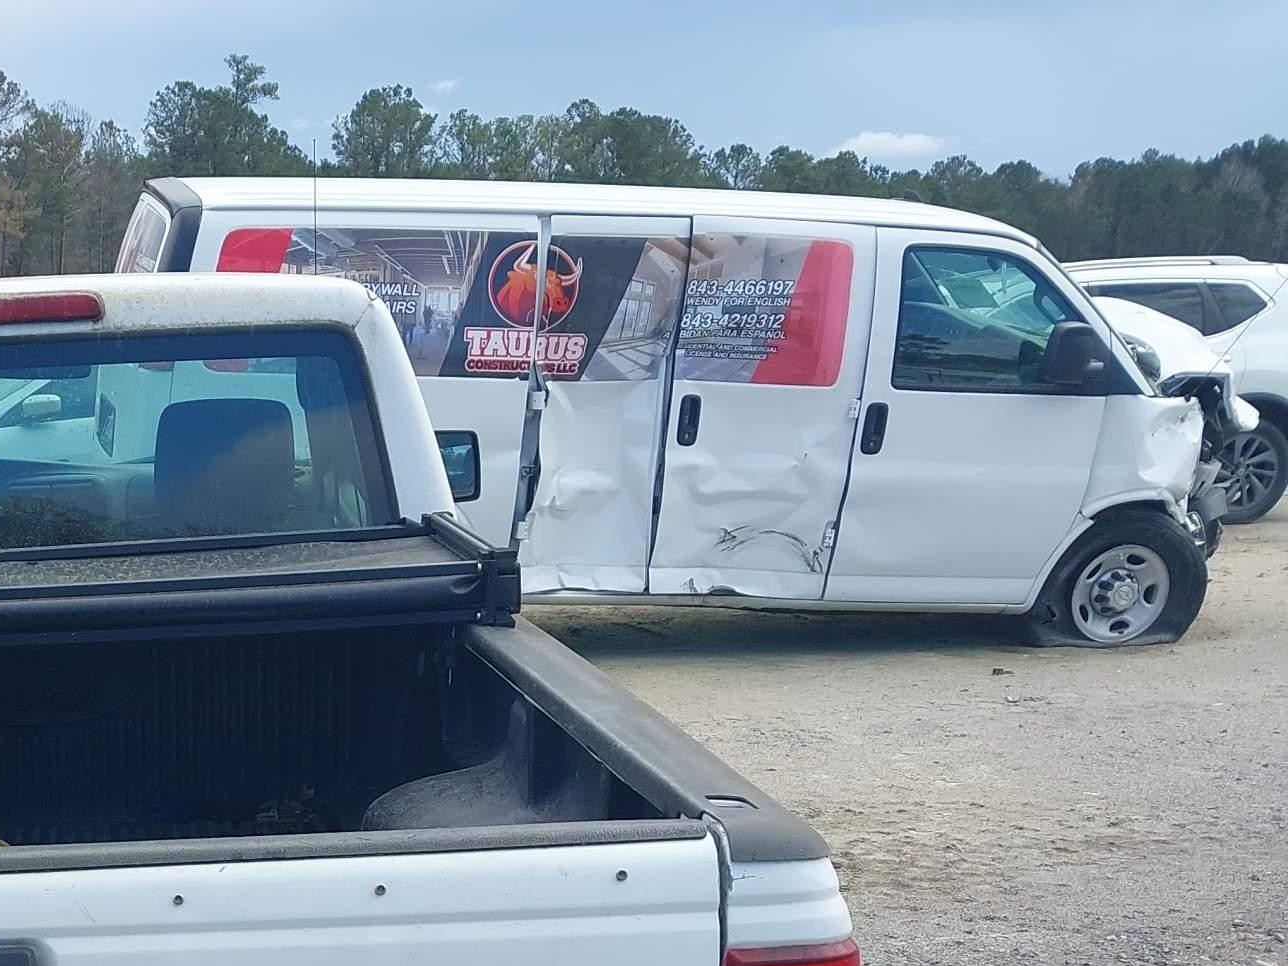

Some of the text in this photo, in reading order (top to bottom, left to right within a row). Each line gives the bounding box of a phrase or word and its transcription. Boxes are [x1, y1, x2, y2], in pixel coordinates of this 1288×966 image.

[687, 280, 794, 295] 843-4466197
[686, 297, 791, 306] WENDY FOR ENGLISH
[680, 313, 785, 328] 843-4219312
[712, 330, 737, 338] PARA
[740, 328, 786, 339] ESPAÑOL
[466, 329, 586, 360] TAURUS
